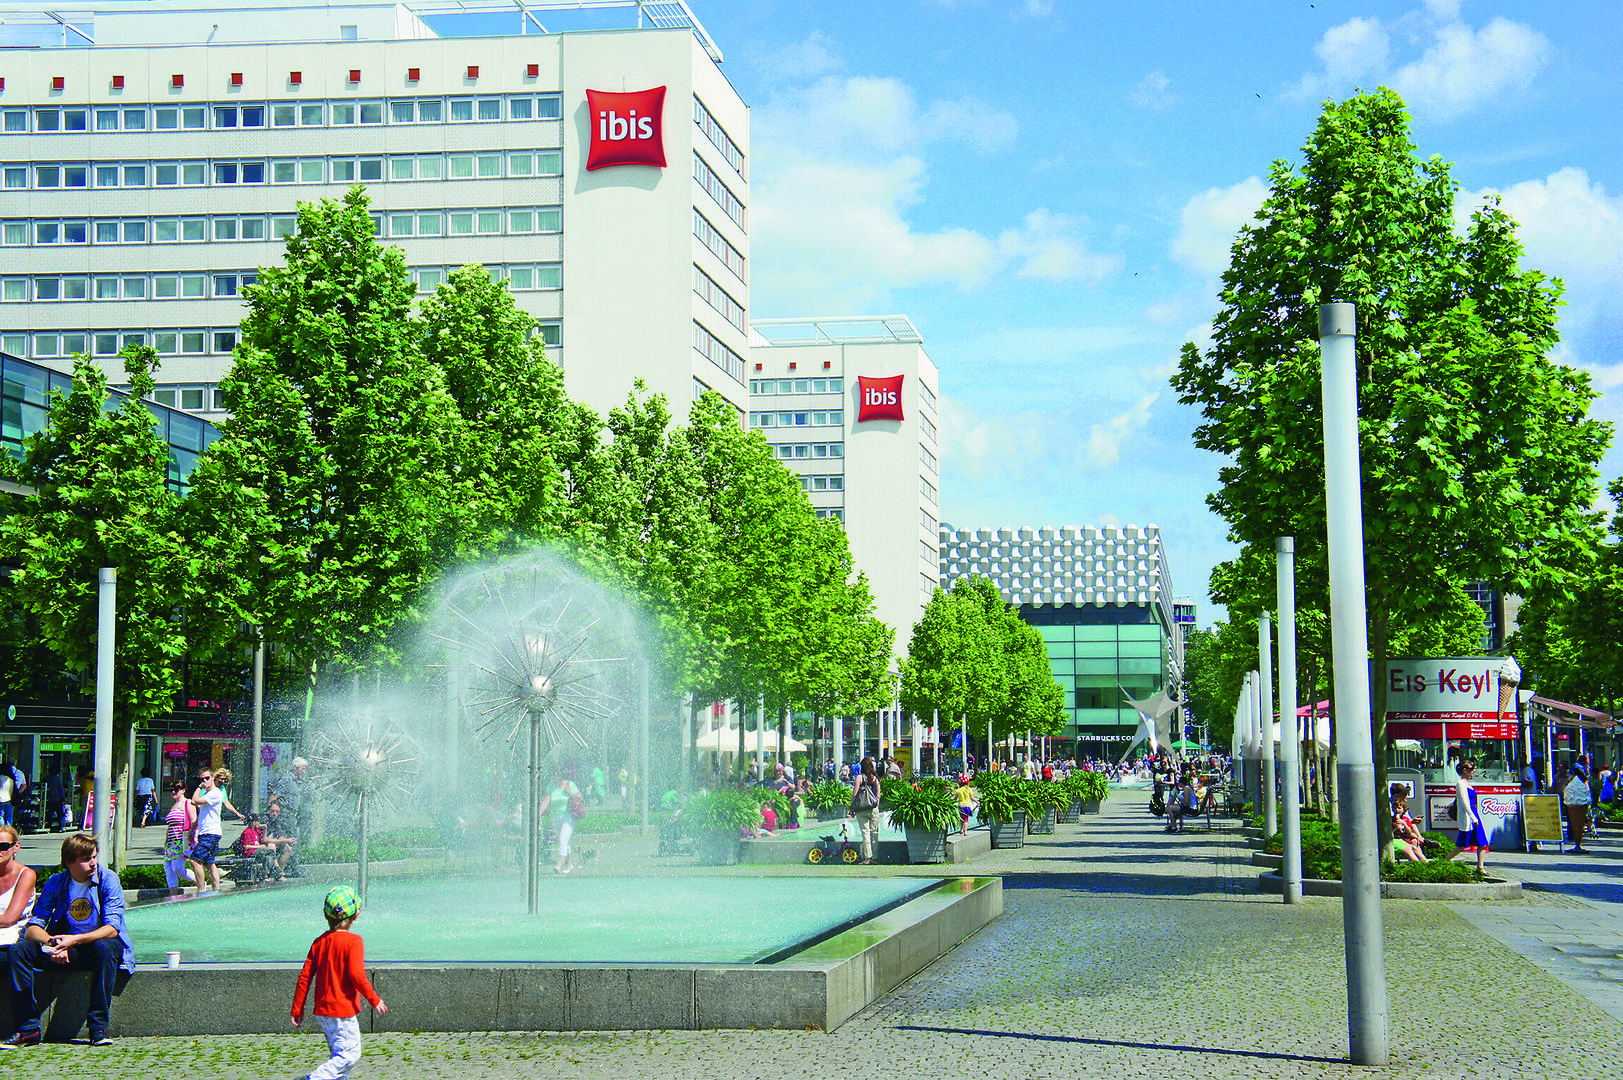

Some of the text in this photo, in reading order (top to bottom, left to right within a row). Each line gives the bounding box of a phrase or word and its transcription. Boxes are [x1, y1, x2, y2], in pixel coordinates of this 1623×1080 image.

[600, 109, 654, 141] ibis
[865, 387, 898, 406] ibis
[1390, 669, 1490, 699] Eis Keyl
